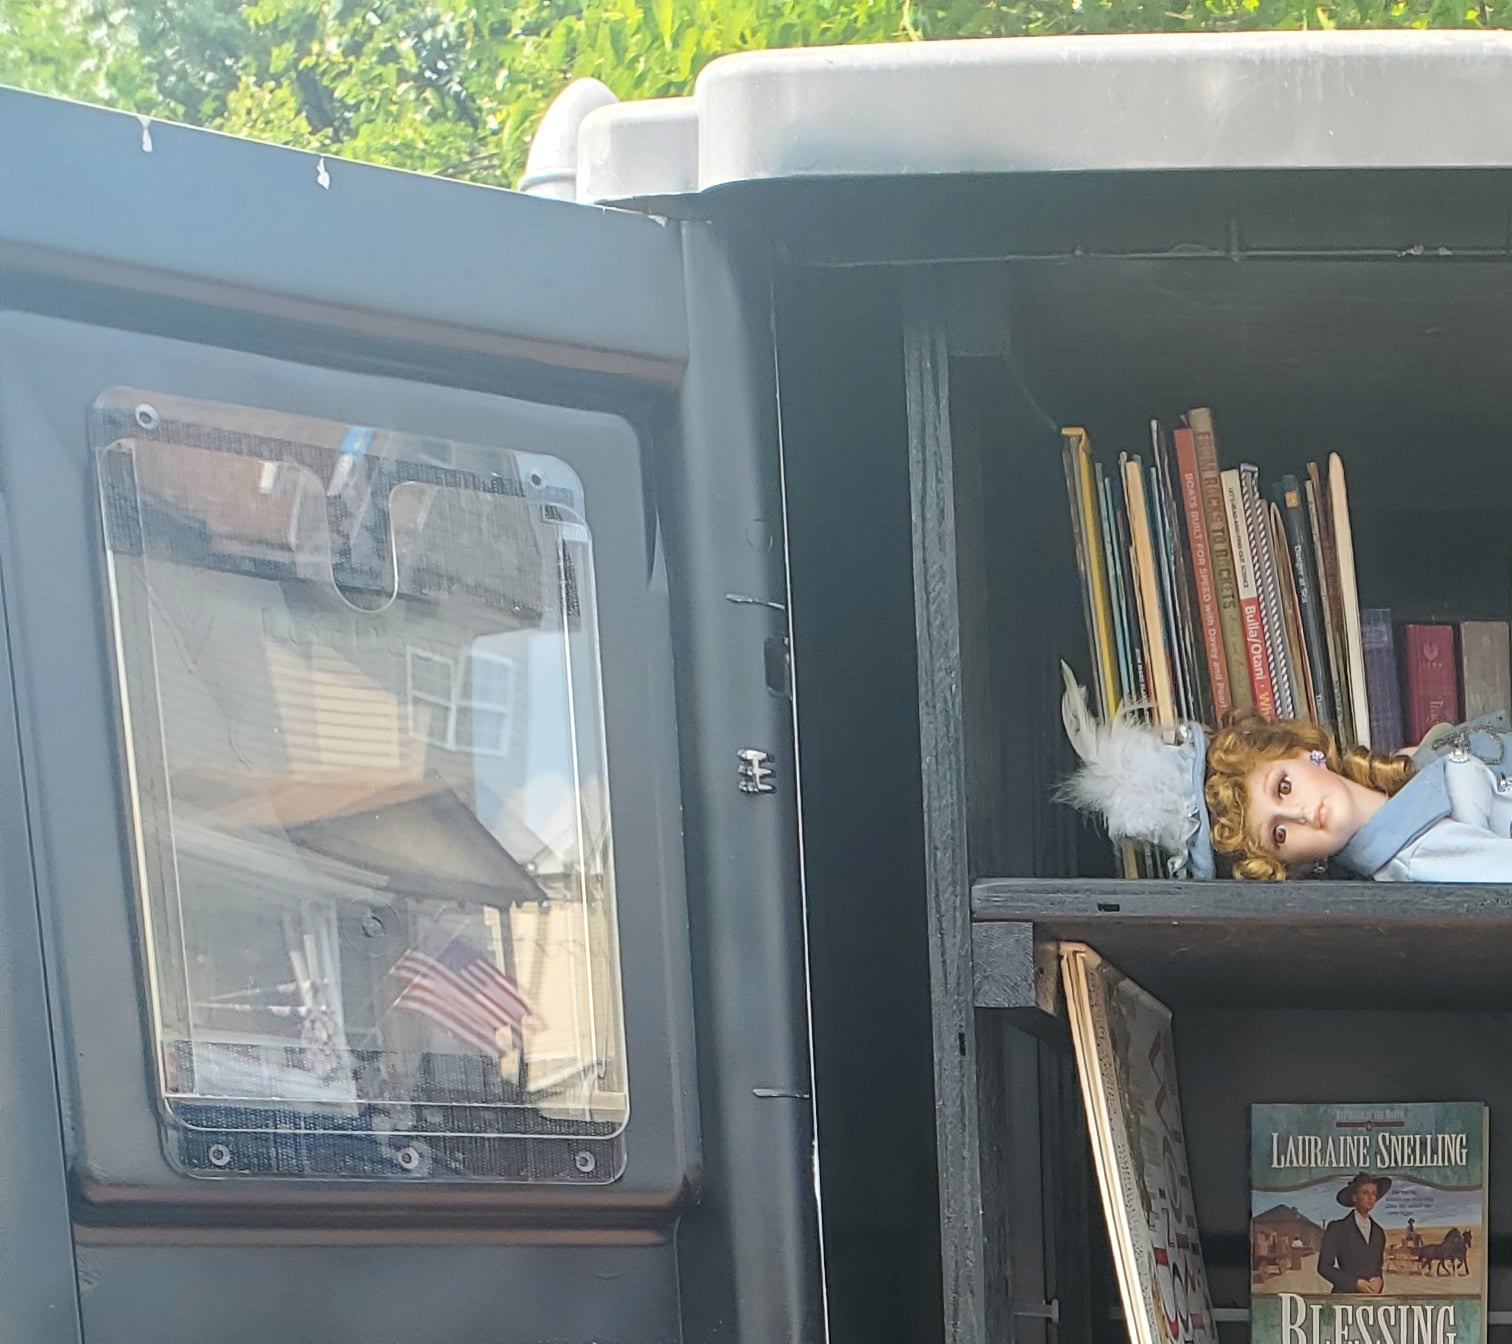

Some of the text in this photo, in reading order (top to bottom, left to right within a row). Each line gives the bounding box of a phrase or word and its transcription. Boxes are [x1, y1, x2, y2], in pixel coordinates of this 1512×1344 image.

[1184, 473, 1228, 708] BOATS BUILT FOR SPEED with Davey and Pearl
[1214, 549, 1235, 609] ROCKETS
[1244, 605, 1265, 680] Bulla/Otani
[1271, 1132, 1468, 1168] LAURAINE SNELLING
